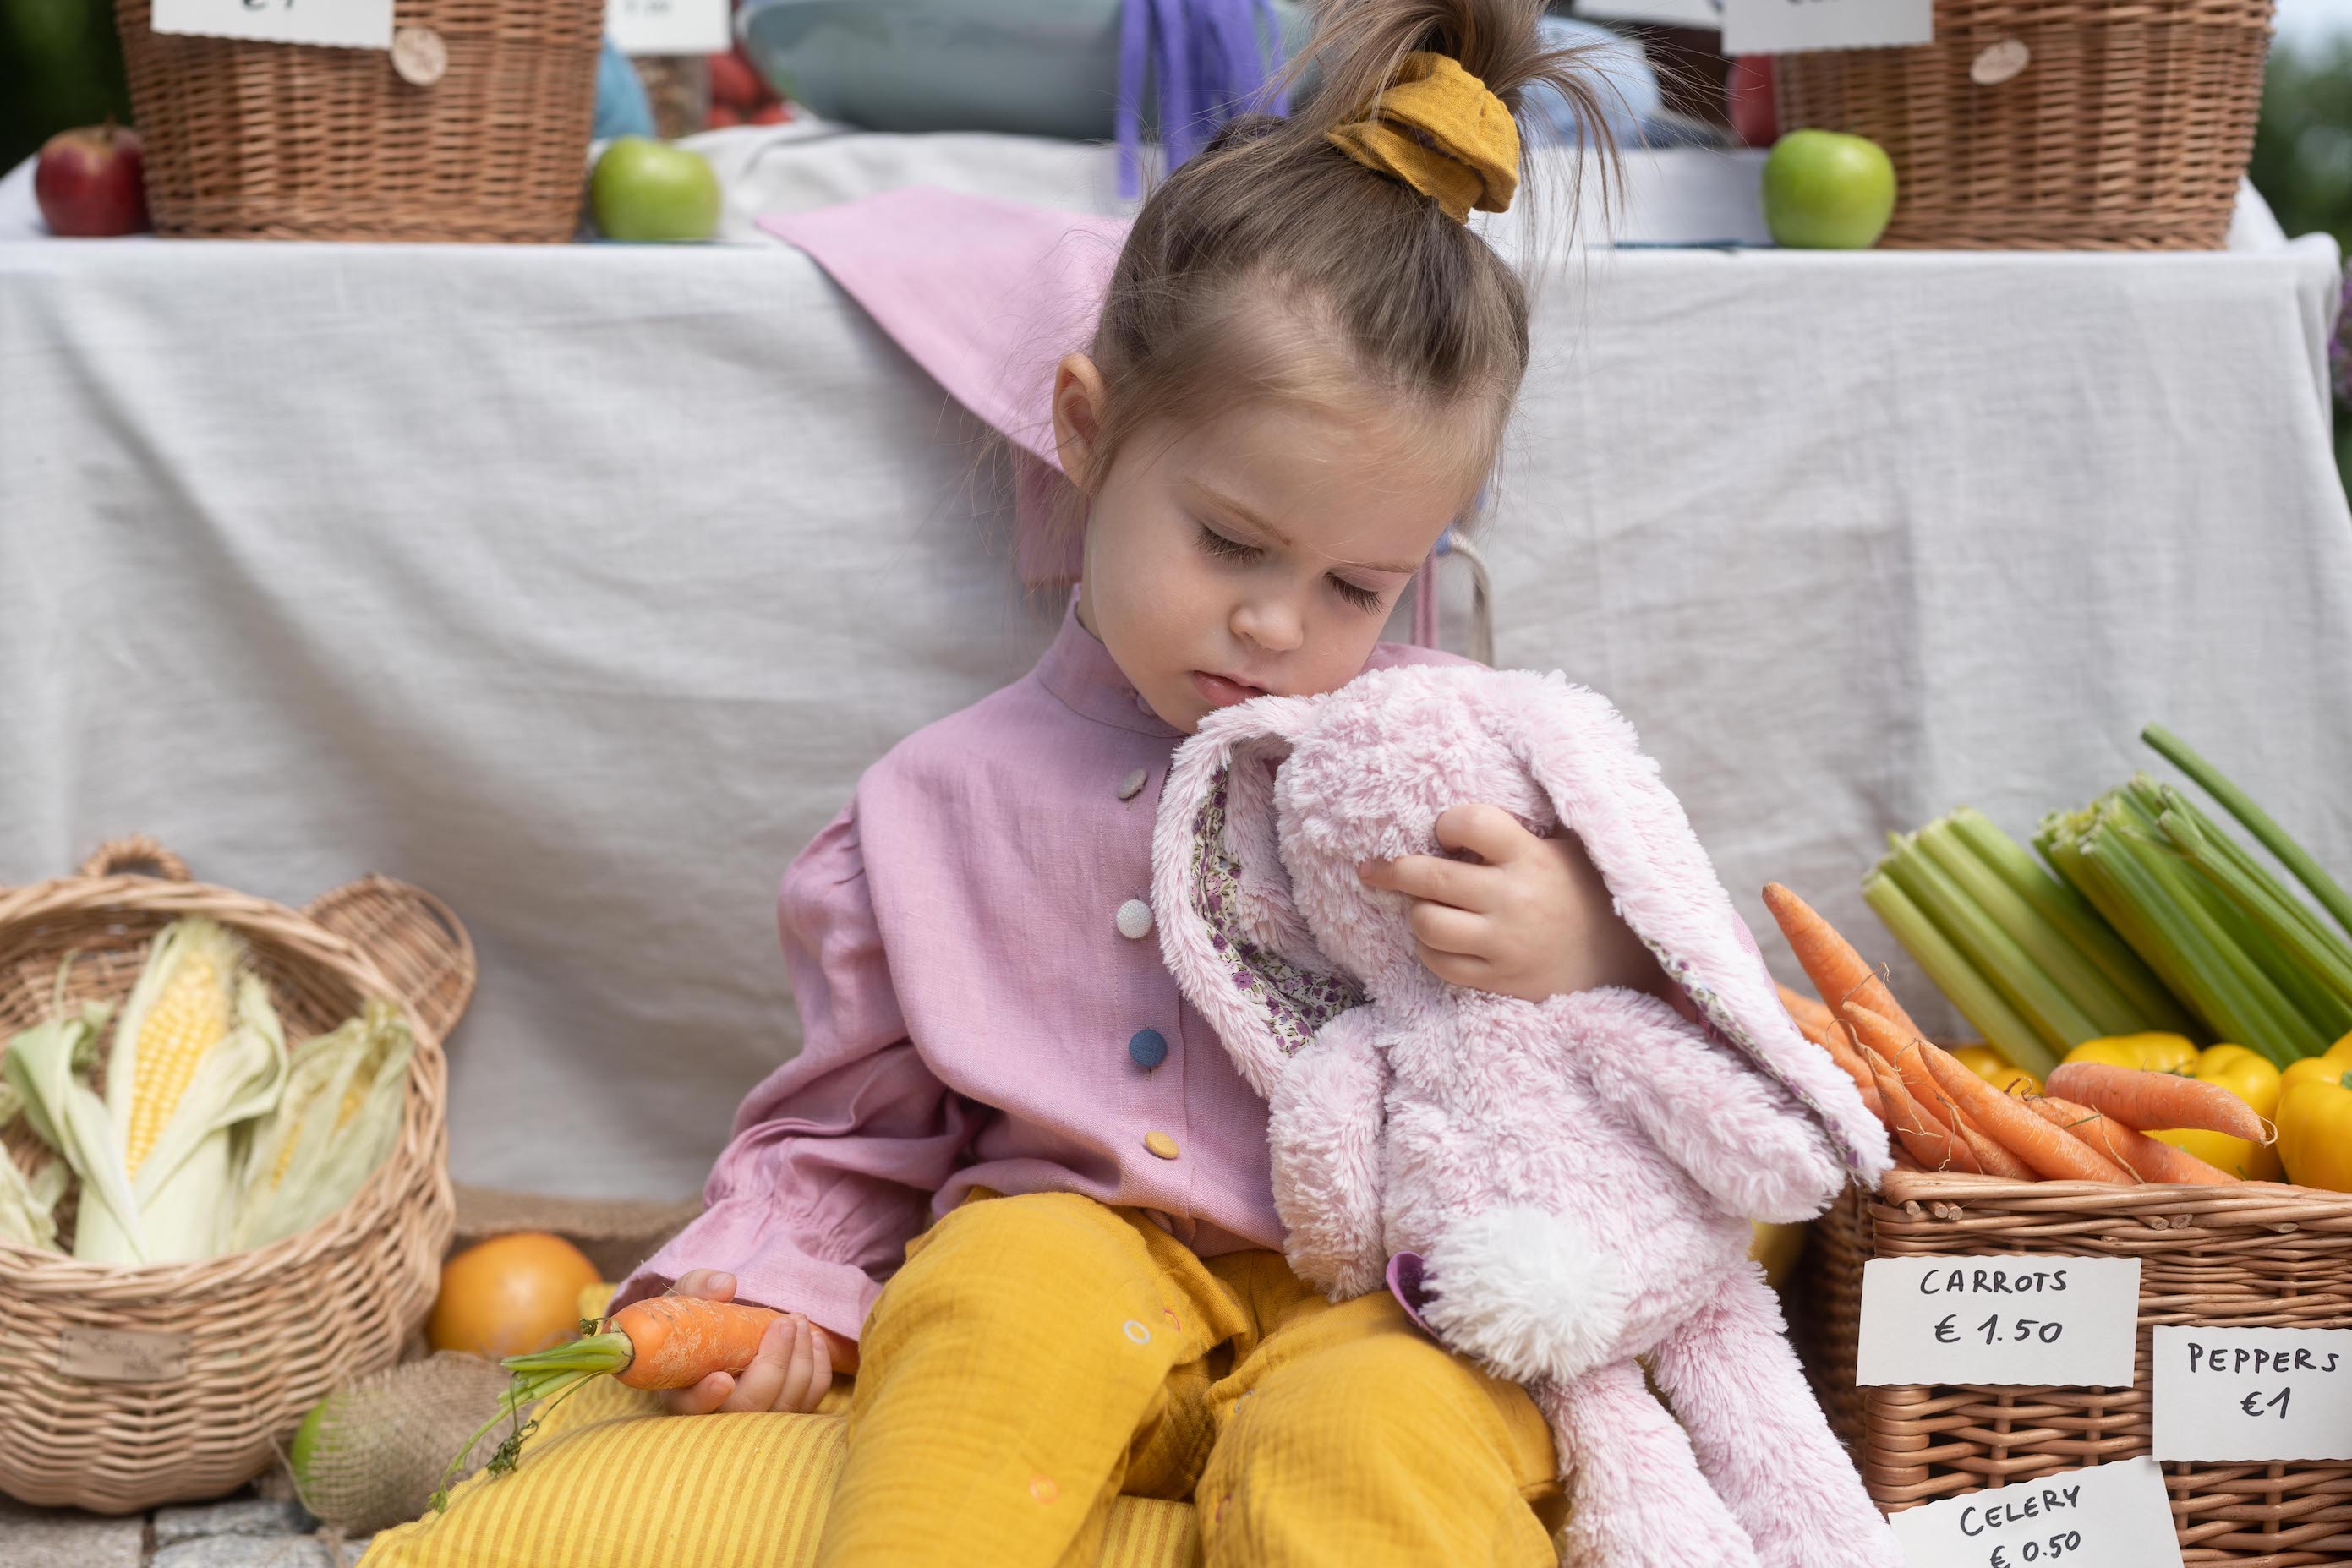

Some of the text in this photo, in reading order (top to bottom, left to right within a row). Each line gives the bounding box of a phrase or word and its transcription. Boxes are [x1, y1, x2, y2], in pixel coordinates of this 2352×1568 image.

[1920, 1269, 2068, 1295] CARROTS
[1934, 1313, 2064, 1346] € 1.50
[2187, 1342, 2340, 1374] PEPPERS
[2240, 1386, 2292, 1420] €1
[1960, 1485, 2081, 1537] CELERY
[2021, 1530, 2082, 1564] 0.50
